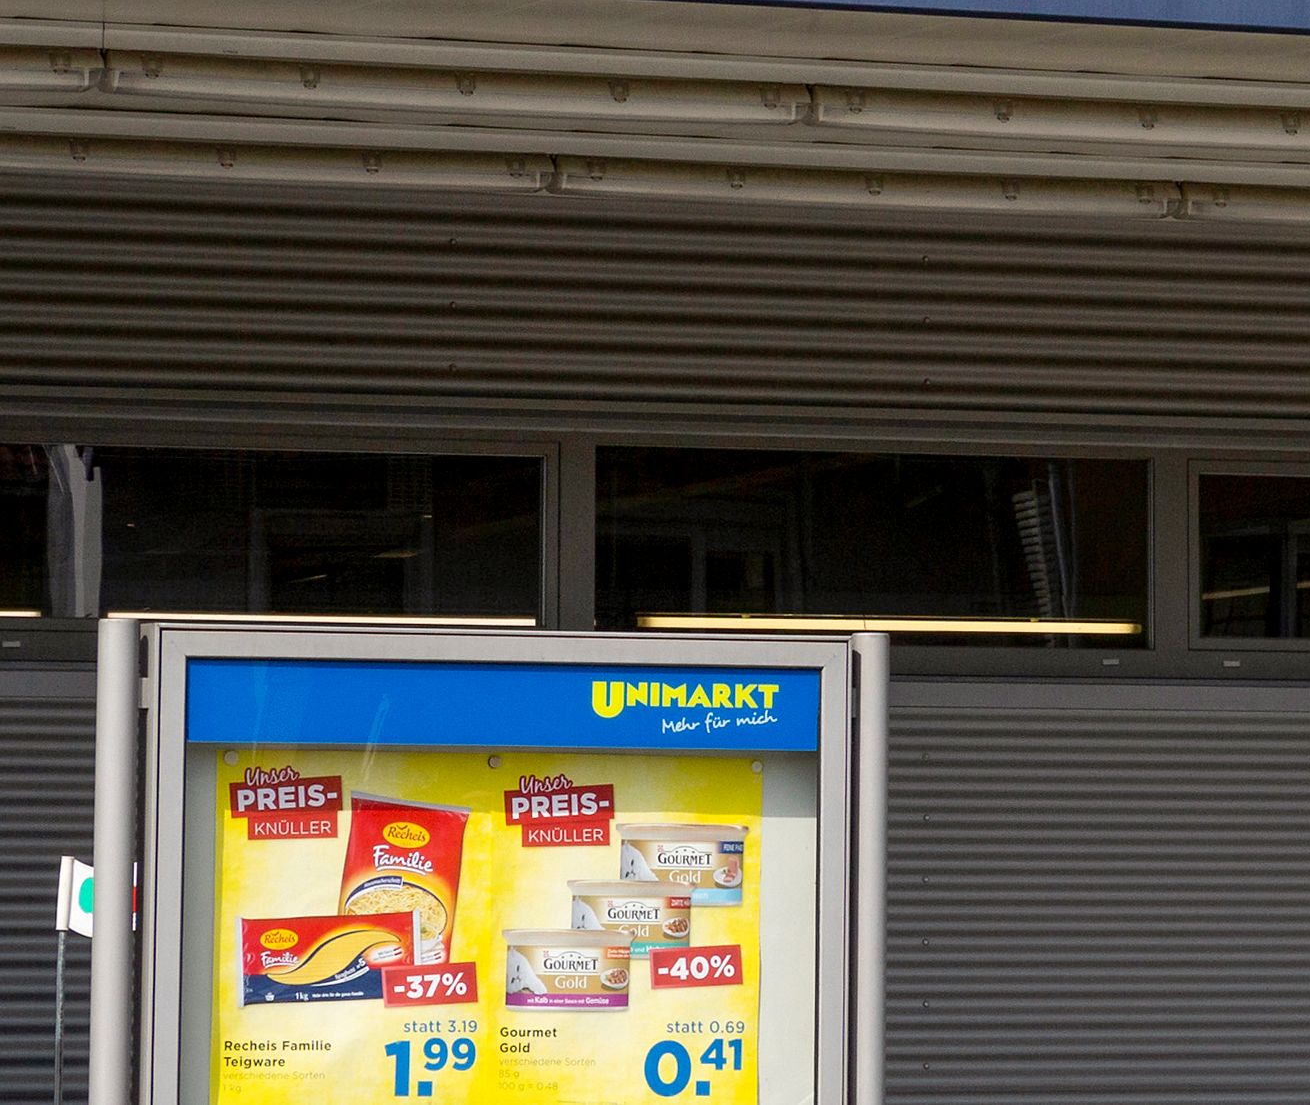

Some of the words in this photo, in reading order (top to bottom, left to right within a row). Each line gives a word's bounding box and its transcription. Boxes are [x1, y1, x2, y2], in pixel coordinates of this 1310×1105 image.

[591, 680, 780, 719] UNIMARKT
[661, 718, 701, 734] Mehr
[705, 712, 731, 734] für
[736, 710, 778, 726] mich
[245, 766, 299, 787] Unser
[520, 774, 574, 794] Unser
[237, 784, 338, 812] PREIS-
[511, 793, 610, 820] PREIS-
[254, 819, 332, 836] KNÜLLER
[387, 826, 428, 843] Recheis
[528, 827, 604, 843] KNÜLLER
[373, 845, 434, 874] Familie
[657, 852, 712, 866] GOURMET
[607, 907, 661, 921] GOURMET
[260, 951, 301, 967] Familie
[543, 958, 599, 972] GOURMET
[657, 955, 736, 981] -40%
[393, 972, 468, 1000] -37%
[554, 975, 587, 989] Gold
[404, 1020, 442, 1033] statt
[448, 1019, 478, 1033] 3.19
[499, 1027, 557, 1038] Gourmet
[666, 1021, 703, 1033] statt
[709, 1020, 745, 1034] 0.69
[224, 1040, 277, 1051] Recheis
[282, 1040, 332, 1051] Familie
[499, 1043, 531, 1053] Gold
[223, 1056, 286, 1069] Teigware
[384, 1037, 477, 1097] 1.99
[499, 1057, 562, 1068] verschiedene
[564, 1057, 596, 1067] Sorten
[644, 1038, 743, 1097] 0.41
[223, 1071, 290, 1080] verschiedene
[292, 1070, 326, 1080] Sorten
